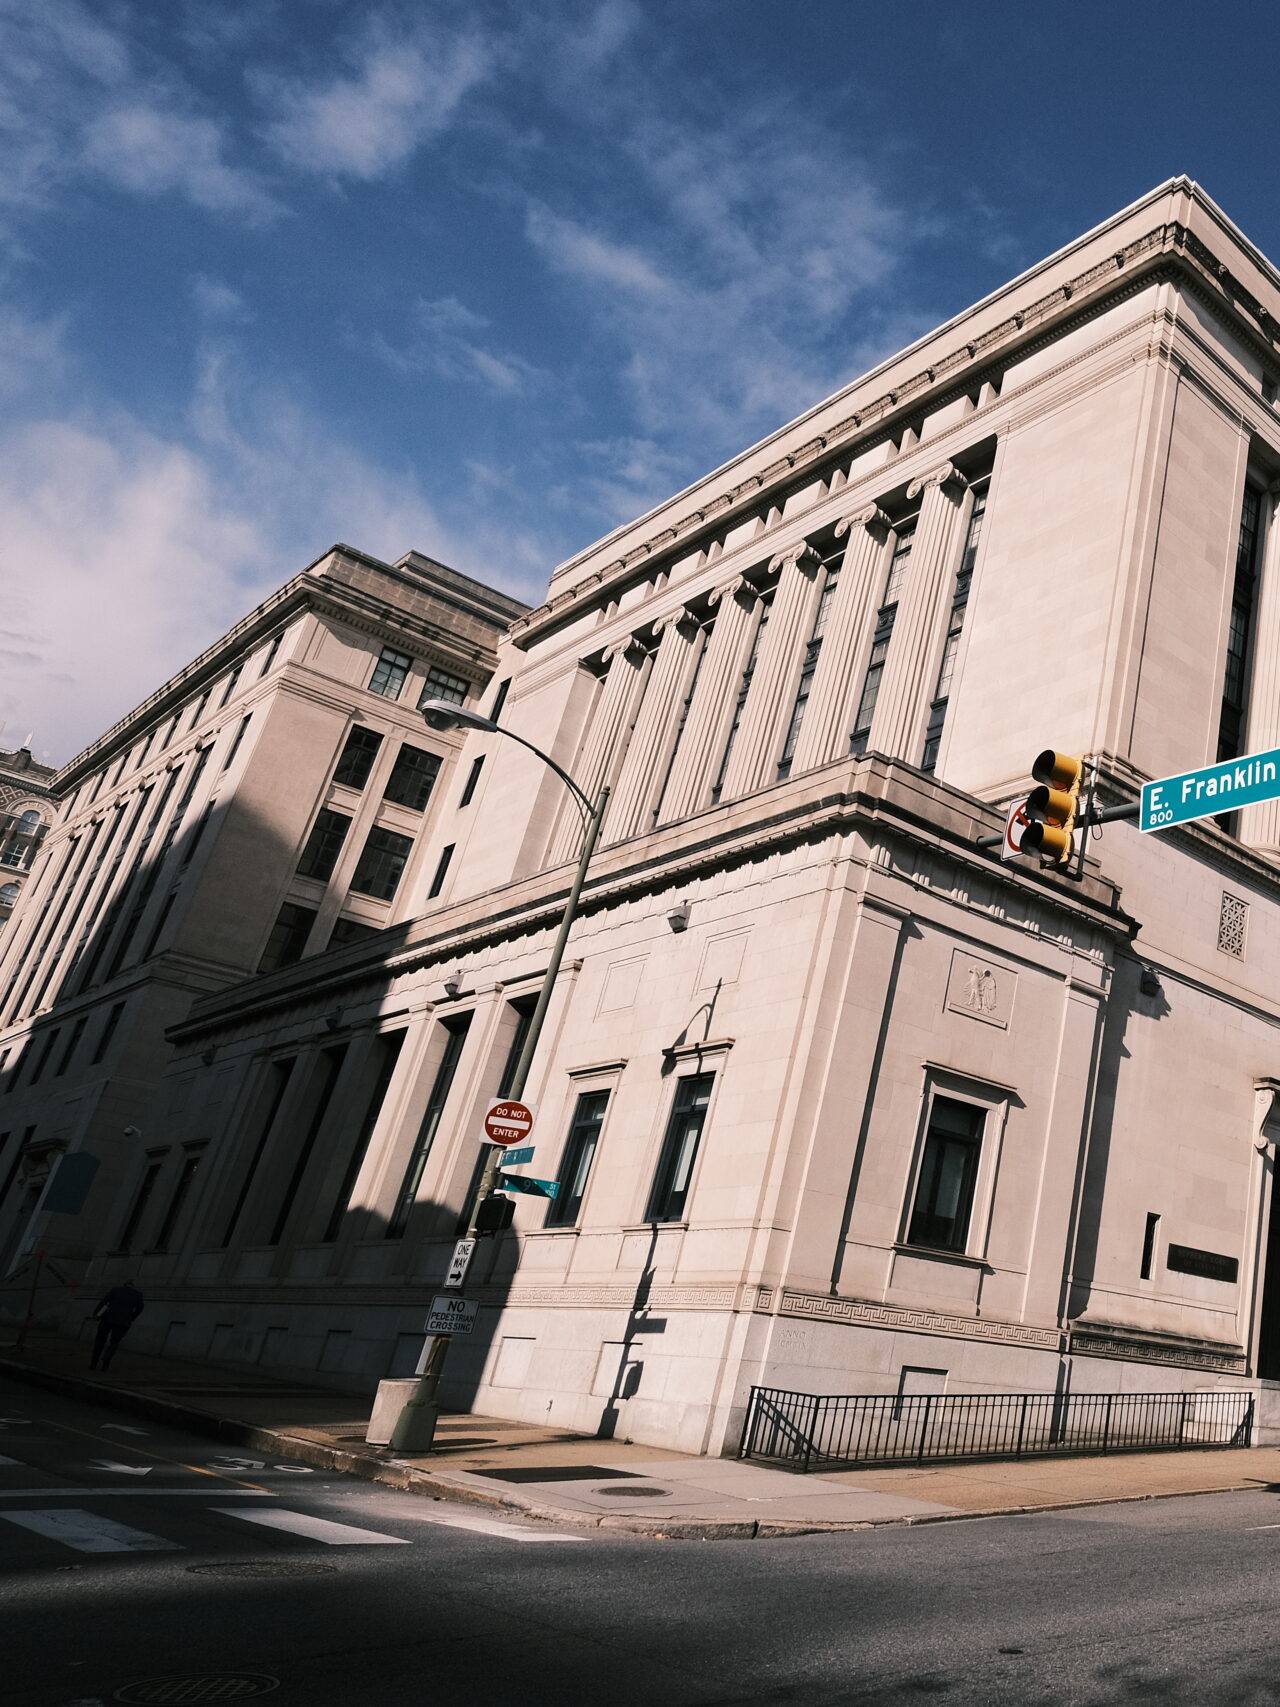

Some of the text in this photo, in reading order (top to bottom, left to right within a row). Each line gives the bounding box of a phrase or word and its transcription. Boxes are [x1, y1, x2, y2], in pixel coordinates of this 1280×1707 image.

[1149, 786, 1169, 812] E.
[1181, 761, 1277, 804] Franklin
[1149, 809, 1174, 825] 800
[496, 1107, 527, 1119] DO NOT
[493, 1127, 519, 1138] ENTER
[457, 1244, 471, 1255] ONE
[453, 1258, 468, 1268] WAY
[447, 1301, 466, 1312] NO
[431, 1311, 475, 1323] PEDESTRIAN
[430, 1321, 471, 1332] CROSSING
